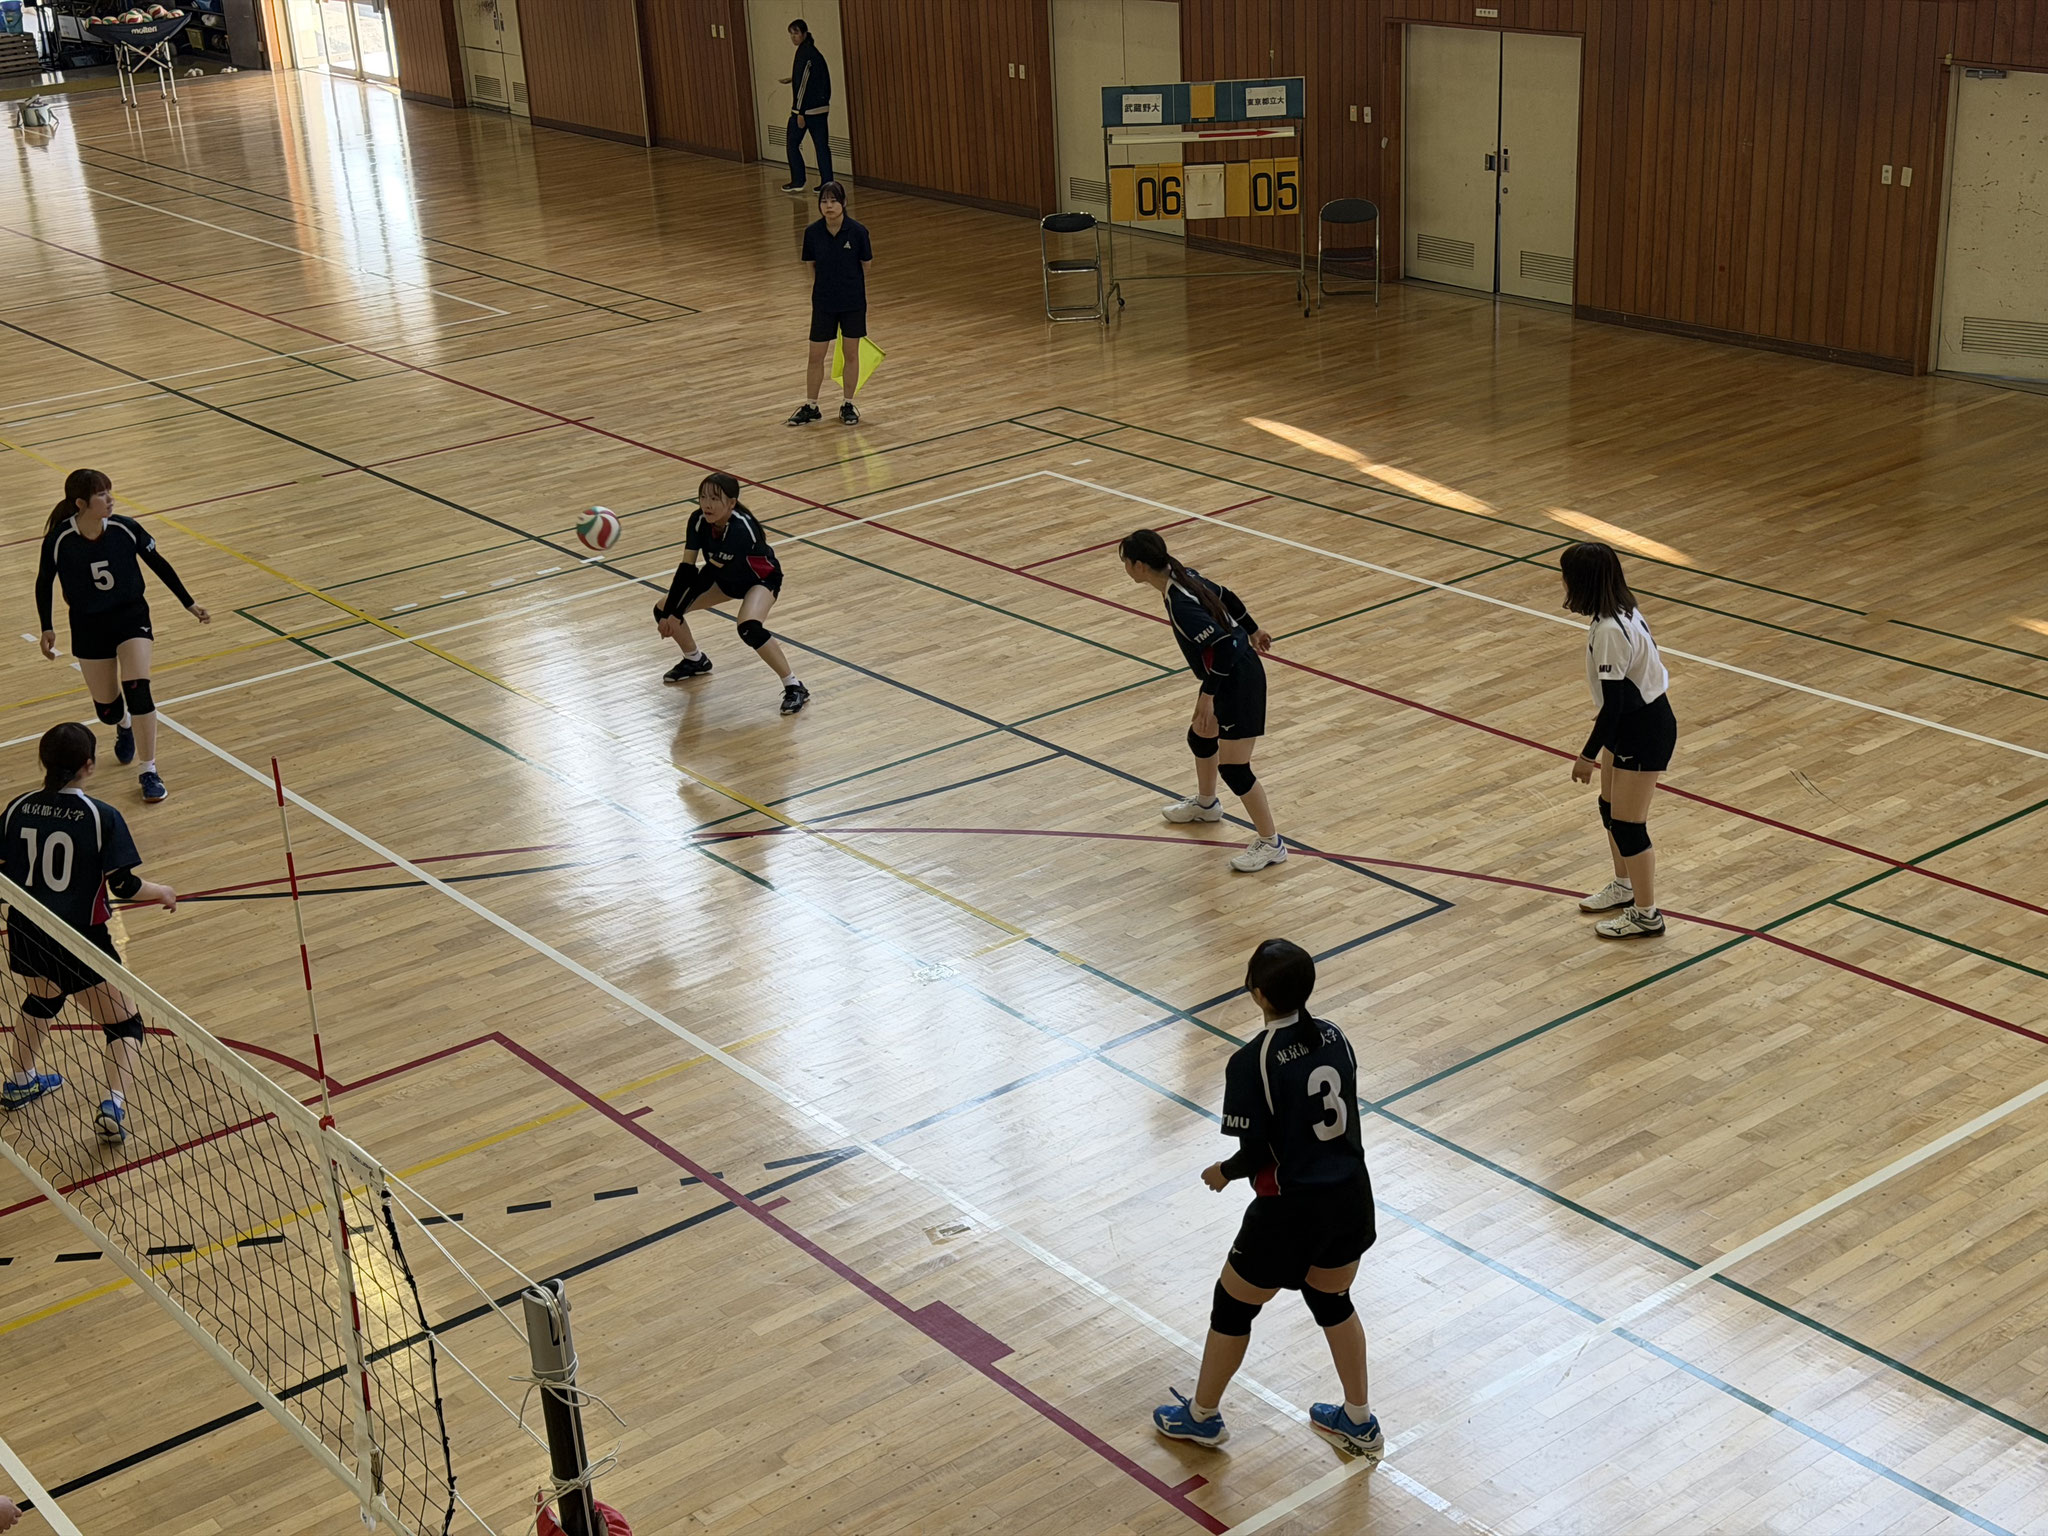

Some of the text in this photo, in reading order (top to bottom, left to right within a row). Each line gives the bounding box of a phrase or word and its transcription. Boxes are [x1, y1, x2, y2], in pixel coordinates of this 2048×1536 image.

[131, 26, 157, 35] molten
[1124, 103, 1160, 113] 武蔵野大
[1247, 97, 1284, 106] 東京都立大
[1138, 176, 1181, 217] 06
[1252, 171, 1298, 211] 05
[90, 560, 115, 591] 5
[1194, 625, 1215, 643] TMU
[20, 827, 74, 892] 10
[1307, 1065, 1348, 1142] 3
